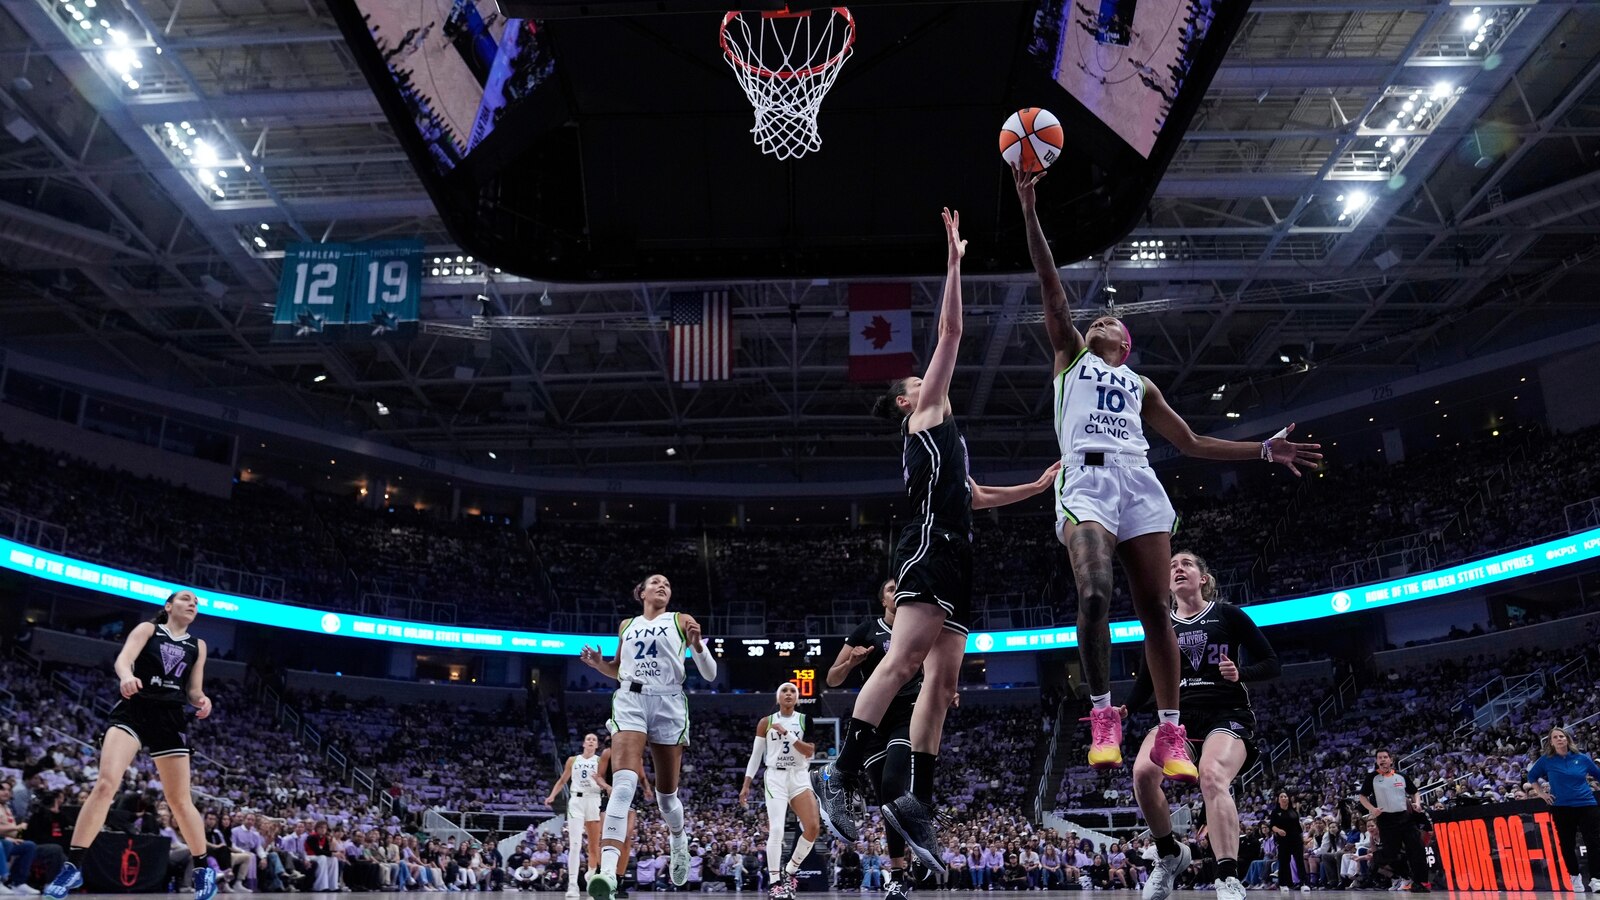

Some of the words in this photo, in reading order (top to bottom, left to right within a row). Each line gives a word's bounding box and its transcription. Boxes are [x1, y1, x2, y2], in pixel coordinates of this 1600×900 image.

[298, 251, 341, 260] MARLEAU
[370, 247, 411, 258] THORNTON
[293, 262, 338, 304] 12
[367, 260, 408, 304] 19
[1079, 365, 1139, 401] LYNX
[1096, 385, 1125, 413] 10
[1089, 413, 1127, 428] MAYO
[1084, 424, 1129, 440] CLINIC
[1391, 585, 1402, 598] OF
[1403, 582, 1420, 595] THE
[1421, 574, 1456, 592] GOLDEN
[1457, 566, 1485, 584] STATE
[1485, 553, 1535, 577] VALKYRIES
[625, 626, 669, 641] LYNX
[634, 640, 658, 660] 24
[748, 645, 764, 657] 30
[174, 661, 187, 678] 0
[792, 669, 815, 680] 7:53
[770, 731, 801, 741] LYX
[782, 741, 790, 754] 3
[581, 769, 588, 779] 8
[1433, 818, 1499, 891] YOUR
